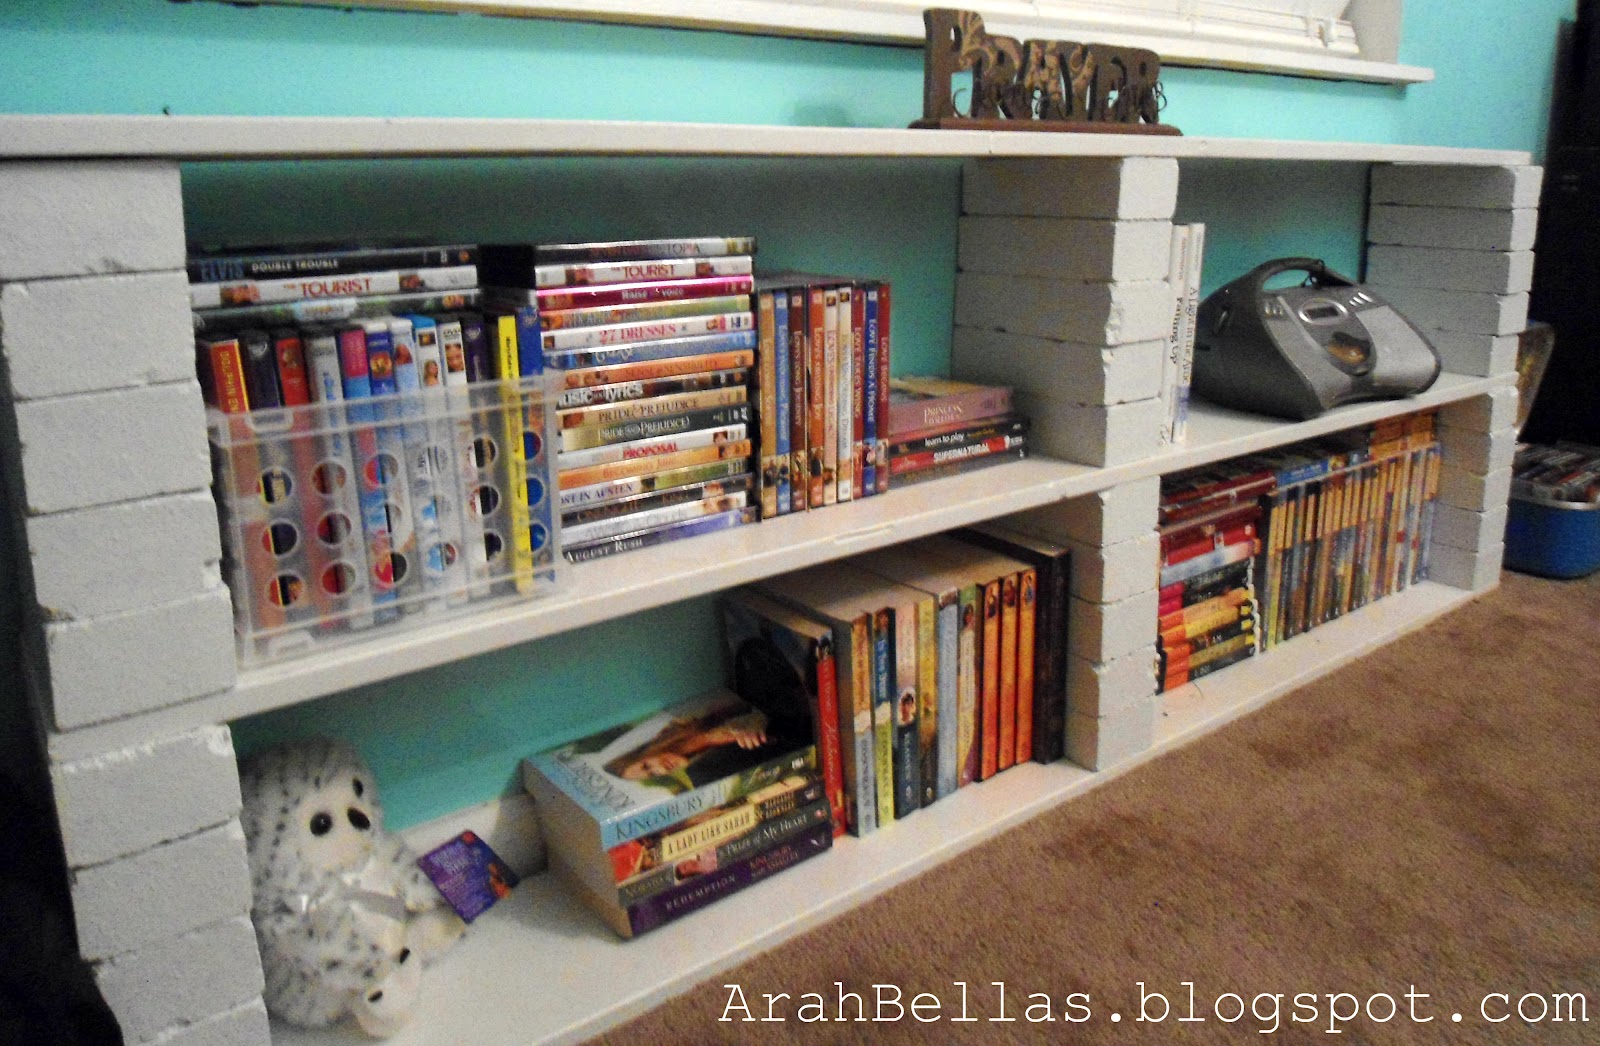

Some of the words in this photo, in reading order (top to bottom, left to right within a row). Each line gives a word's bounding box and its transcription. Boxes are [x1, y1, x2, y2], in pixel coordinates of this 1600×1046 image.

[923, 8, 1162, 124] PRAYER
[252, 260, 292, 272] DOUBLE
[297, 257, 340, 270] TROUBLE
[623, 263, 675, 279] TOURIST
[300, 278, 373, 298] TOURIST
[1189, 286, 1198, 297] A
[1169, 296, 1183, 343] Falling
[1184, 299, 1198, 323] Light
[599, 329, 616, 345] 27
[620, 323, 677, 341] DRESSES
[854, 326, 862, 354] LOVE
[867, 318, 877, 345] LOVE
[880, 336, 888, 363] LOVE
[1169, 345, 1180, 365] Up
[854, 355, 862, 386] TAKES
[867, 347, 876, 378] FINDS
[880, 364, 888, 402] BEGINS
[598, 408, 632, 423] PRIDE
[640, 398, 698, 417] PREJUDICE
[853, 387, 862, 419] WING
[866, 390, 876, 422] HOME
[622, 442, 678, 460] PROPOSAL
[924, 436, 942, 447] learn
[942, 434, 949, 443] to
[950, 431, 965, 445] play
[933, 442, 990, 463] SUPERNATURAL
[595, 482, 634, 499] AUSTEN
[566, 545, 610, 563] AUGUST
[615, 538, 644, 552] RUSH
[614, 794, 704, 840] KINGSBURY
[779, 812, 808, 833] HEART
[676, 832, 698, 851] LADY
[700, 822, 722, 842] LIKE
[724, 811, 751, 834] SARAH
[665, 873, 737, 911] REDEMPTION
